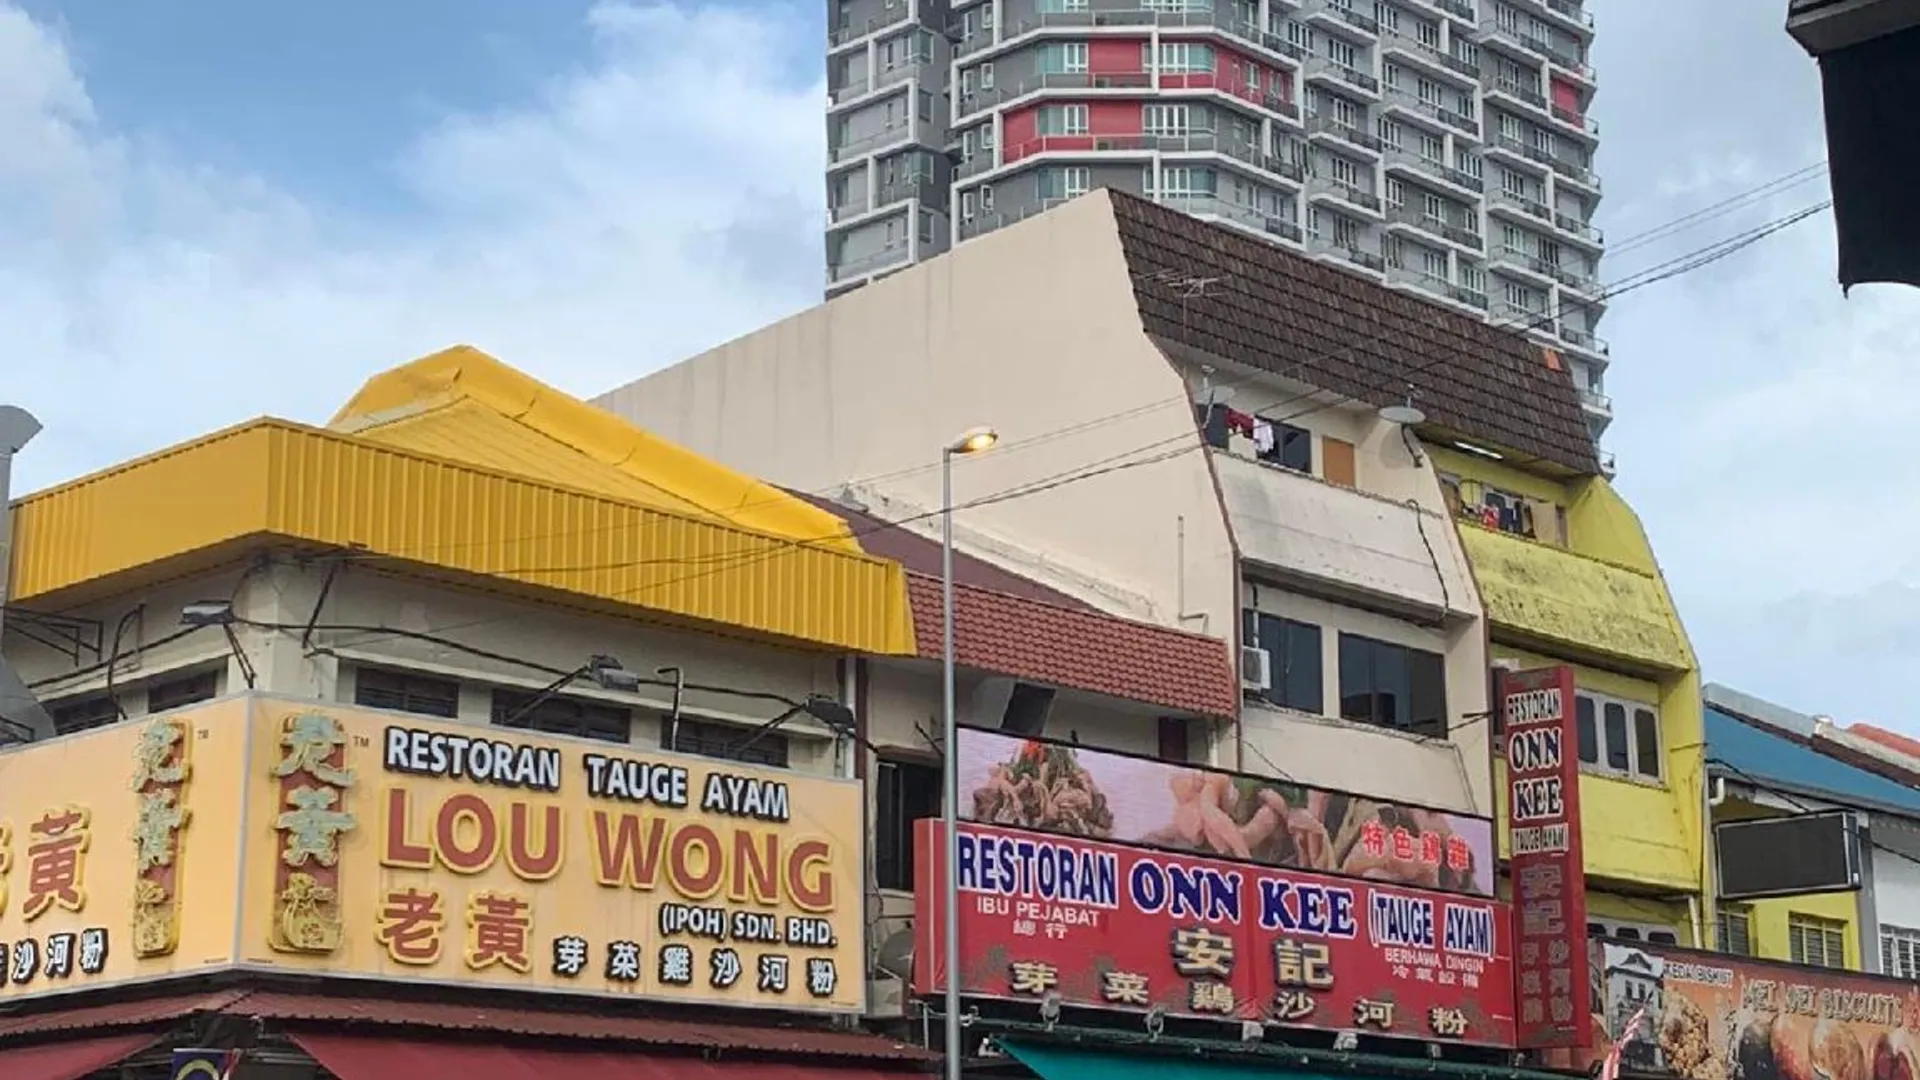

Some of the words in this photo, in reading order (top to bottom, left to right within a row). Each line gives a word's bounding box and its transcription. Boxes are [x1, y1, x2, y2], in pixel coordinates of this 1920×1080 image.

[1507, 688, 1563, 725] RESTORAN
[1509, 728, 1562, 771] ONN
[385, 727, 561, 790] RESTORAN
[585, 756, 688, 806] TAUGE
[704, 775, 789, 821] AYAM
[1513, 777, 1563, 821] KEE
[384, 787, 564, 879] LOU
[591, 810, 834, 910] WONG
[958, 833, 1118, 909] RESTORAN
[1129, 858, 1243, 922] ONN
[1259, 877, 1356, 939] KEE
[661, 903, 728, 941] (IPOH)
[733, 912, 782, 944] SDN.
[786, 916, 838, 947] BHD.
[977, 896, 1009, 915] IBU
[1016, 902, 1100, 928] PEJABAT
[0, 928, 108, 989] 沙河粉
[1173, 927, 1335, 989] 安記
[1385, 947, 1442, 968] BERHAWA
[1446, 955, 1484, 974] DINGIN
